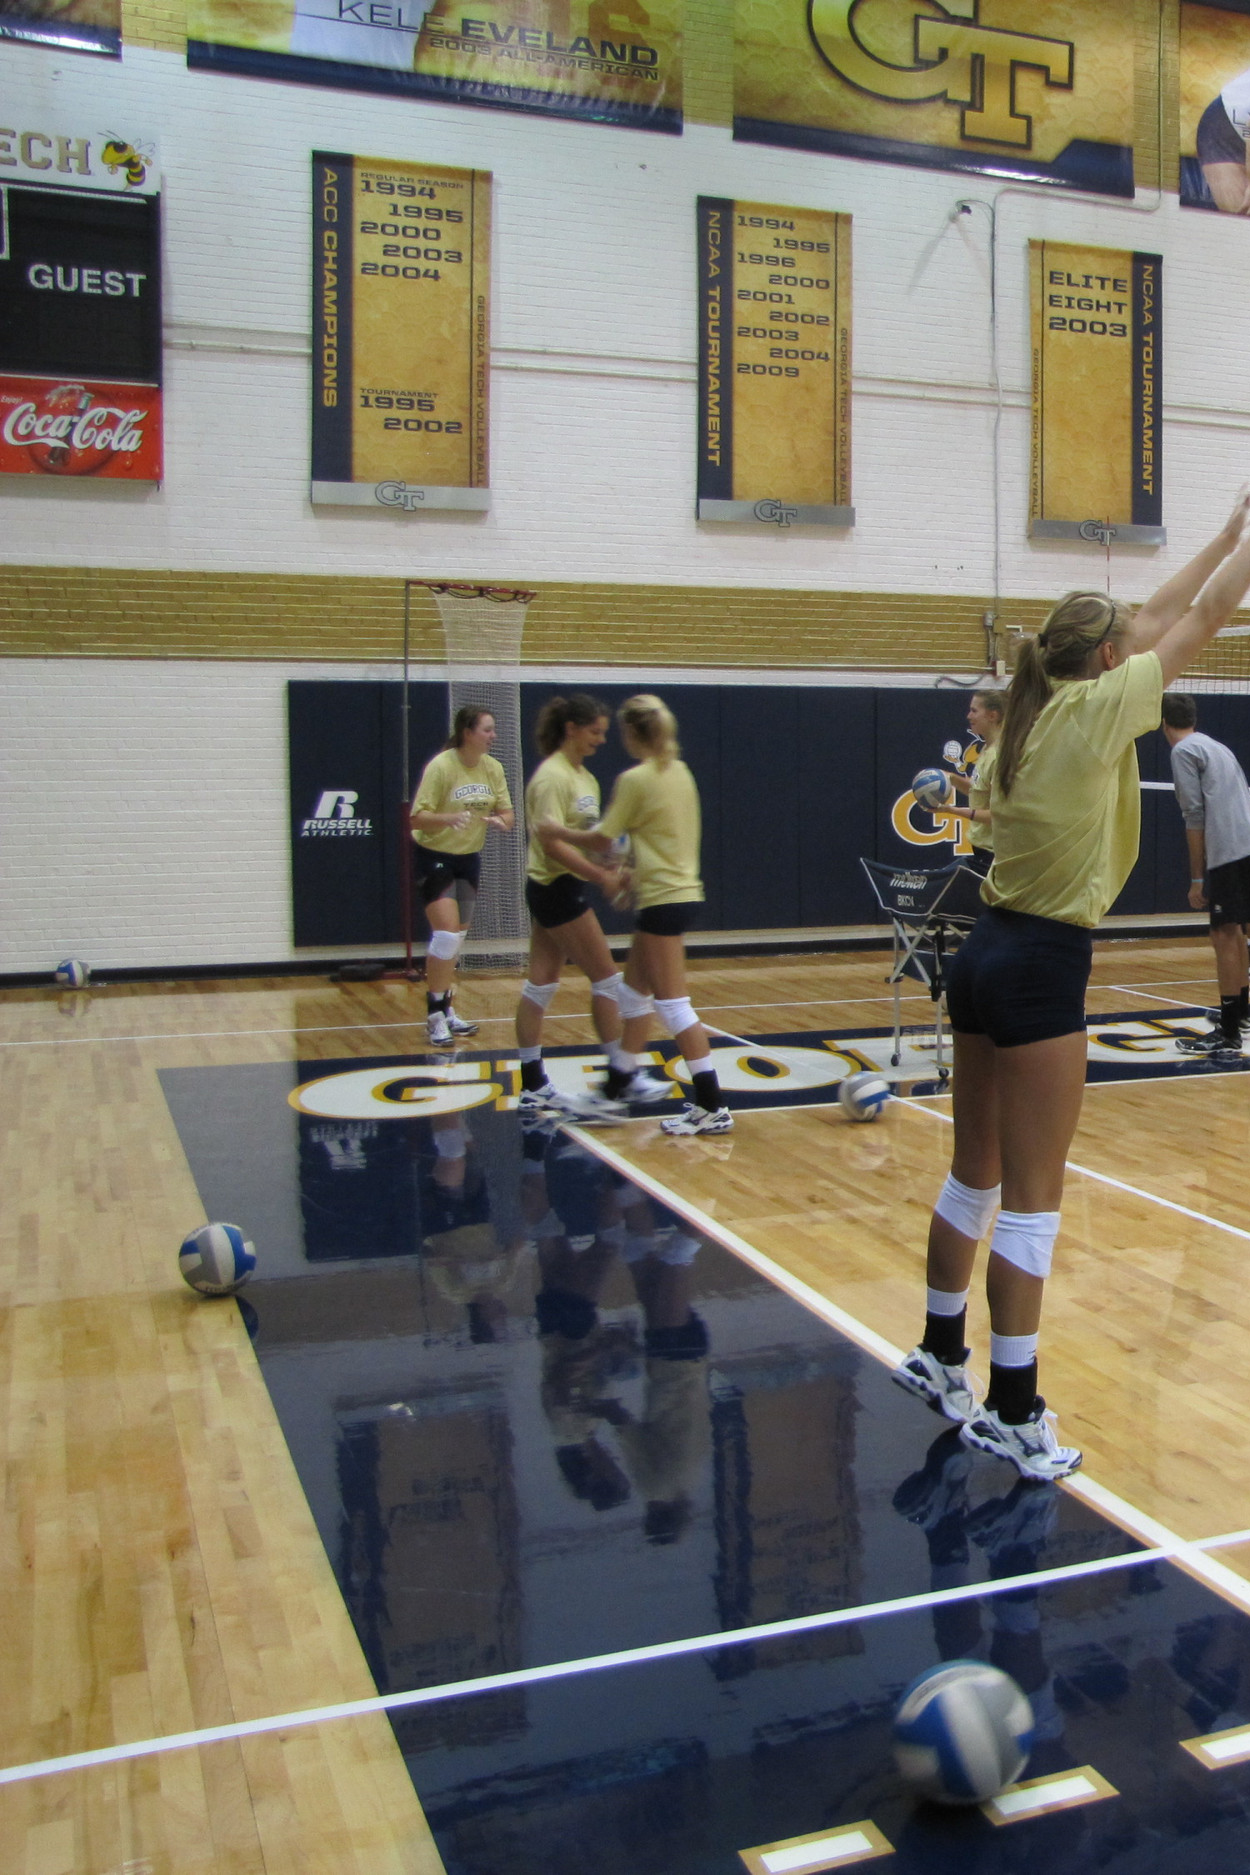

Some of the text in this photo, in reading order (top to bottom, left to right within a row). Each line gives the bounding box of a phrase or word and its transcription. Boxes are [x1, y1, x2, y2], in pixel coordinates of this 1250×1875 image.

[337, 0, 659, 66] KELE EVELAND
[430, 39, 660, 82] 2003 ALL-AMERICAN
[806, 0, 1074, 151] GT
[360, 172, 464, 189] REGULAR SEASON
[360, 180, 437, 200] 1994
[389, 203, 464, 223] 1995
[360, 221, 441, 241] 2000
[737, 215, 796, 232] 1994
[382, 244, 463, 264] 2003
[773, 238, 830, 254] 1995
[737, 252, 796, 268] 1996
[28, 263, 147, 297] GUEST
[360, 262, 441, 282] 2004
[768, 274, 830, 290] 2000
[1049, 270, 1128, 293] ELITE
[323, 167, 338, 408] ACC CHAMPIONS
[737, 289, 795, 305] 2001
[1049, 294, 1128, 315] EIGHT
[769, 311, 830, 326] 2002
[1048, 316, 1128, 338] 2003
[707, 211, 721, 467] NCAA TOURNAMENT
[737, 326, 799, 341] 2003
[769, 347, 830, 362] 2004
[737, 363, 800, 378] 2009
[1142, 265, 1153, 496] NCAA TOURNAMENT
[360, 388, 439, 399] TOURNAMENT
[476, 295, 486, 486] GEORGIA TECH VOLLEYBALL
[360, 395, 435, 412] 1995
[383, 417, 463, 434] 2002
[839, 328, 849, 505] GEORGIA TECH VOLLEYBALL
[3, 402, 148, 452] Coca-Cola
[375, 481, 424, 512] GT
[753, 499, 797, 527] GT
[1079, 519, 1116, 546] GT
[301, 829, 374, 837] ATHLETIC
[303, 819, 373, 829] RUSSELL
